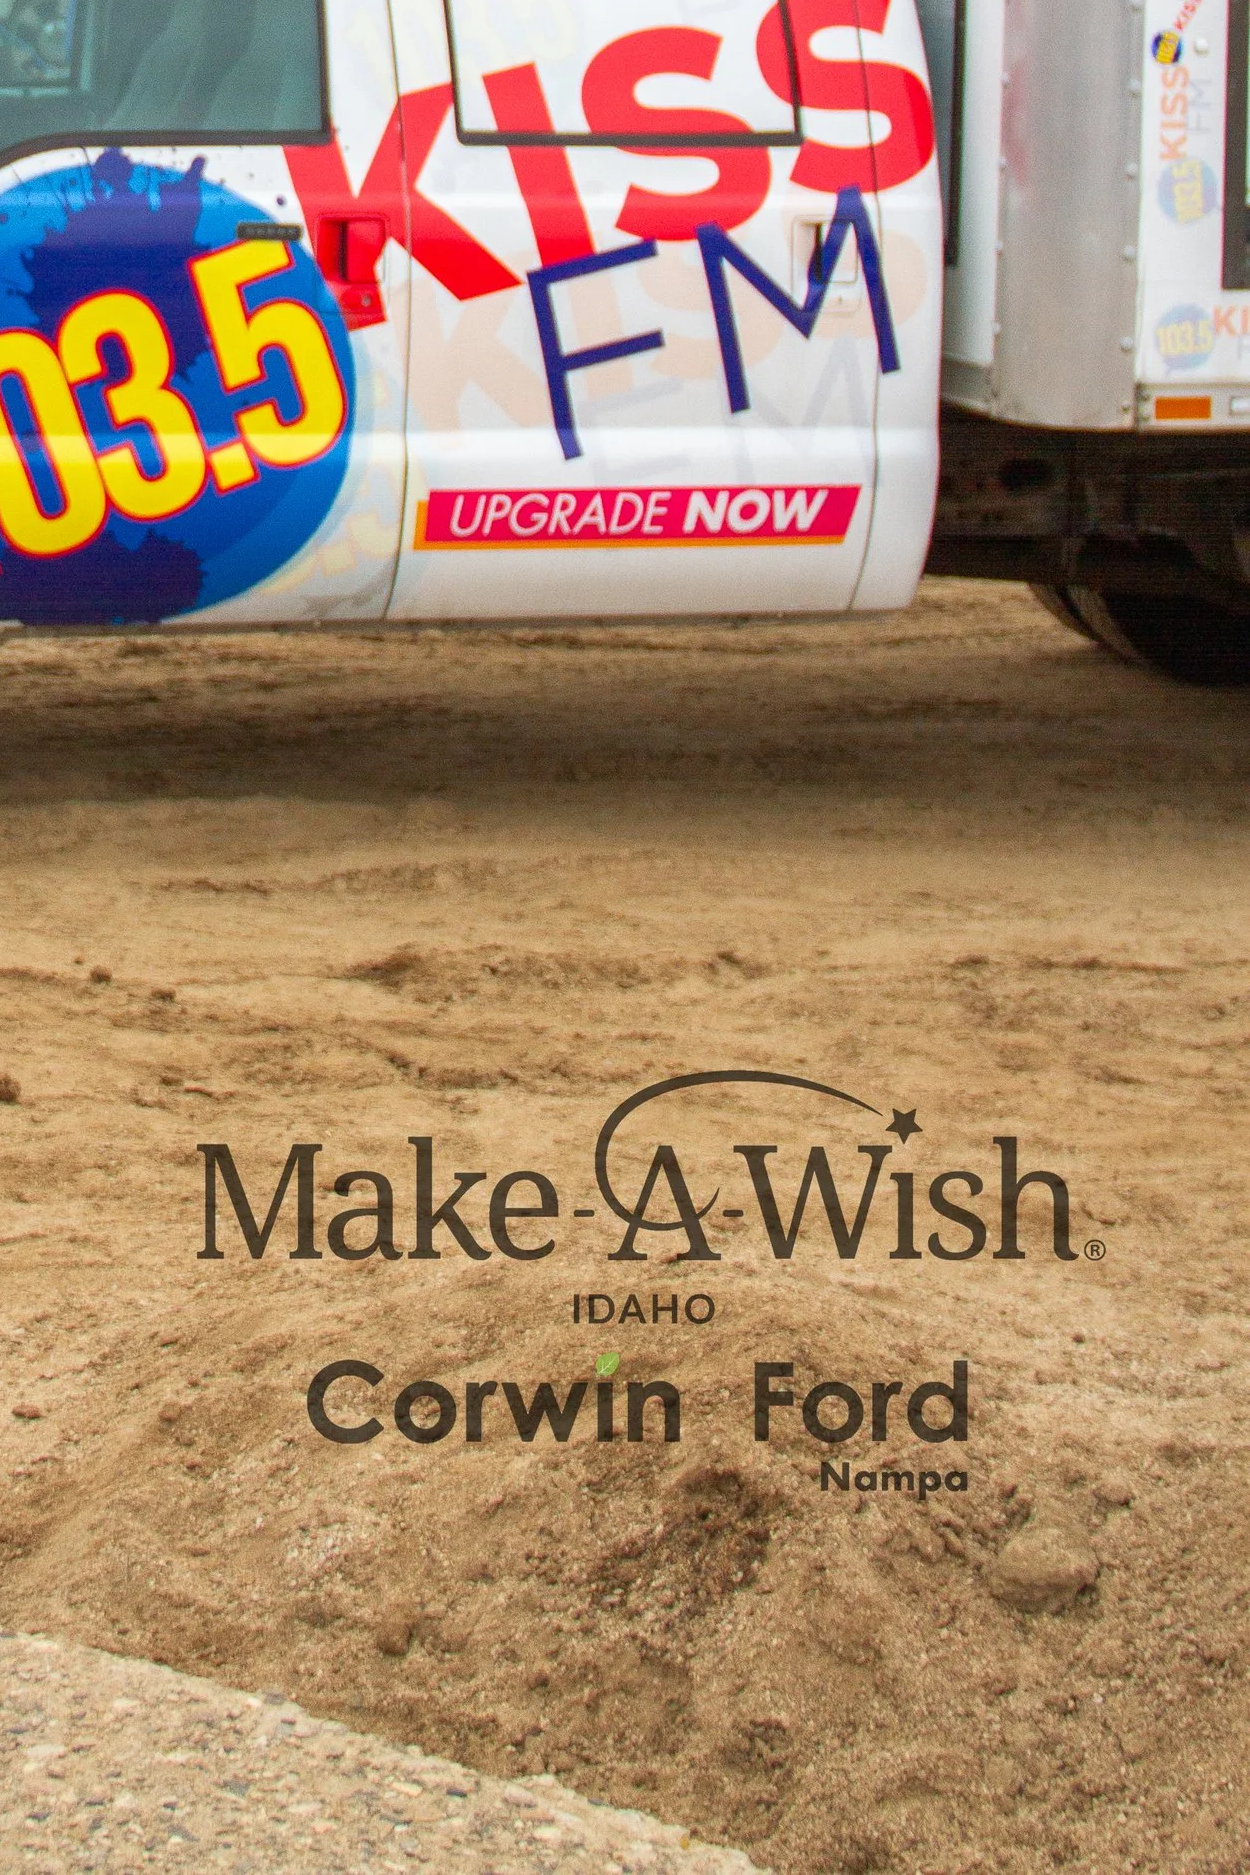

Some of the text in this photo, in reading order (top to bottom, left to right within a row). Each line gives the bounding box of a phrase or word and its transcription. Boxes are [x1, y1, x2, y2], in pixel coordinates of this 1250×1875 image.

[1160, 65, 1190, 161] KISS
[527, 185, 901, 461] FM
[451, 488, 828, 537] UPGRADE NOW
